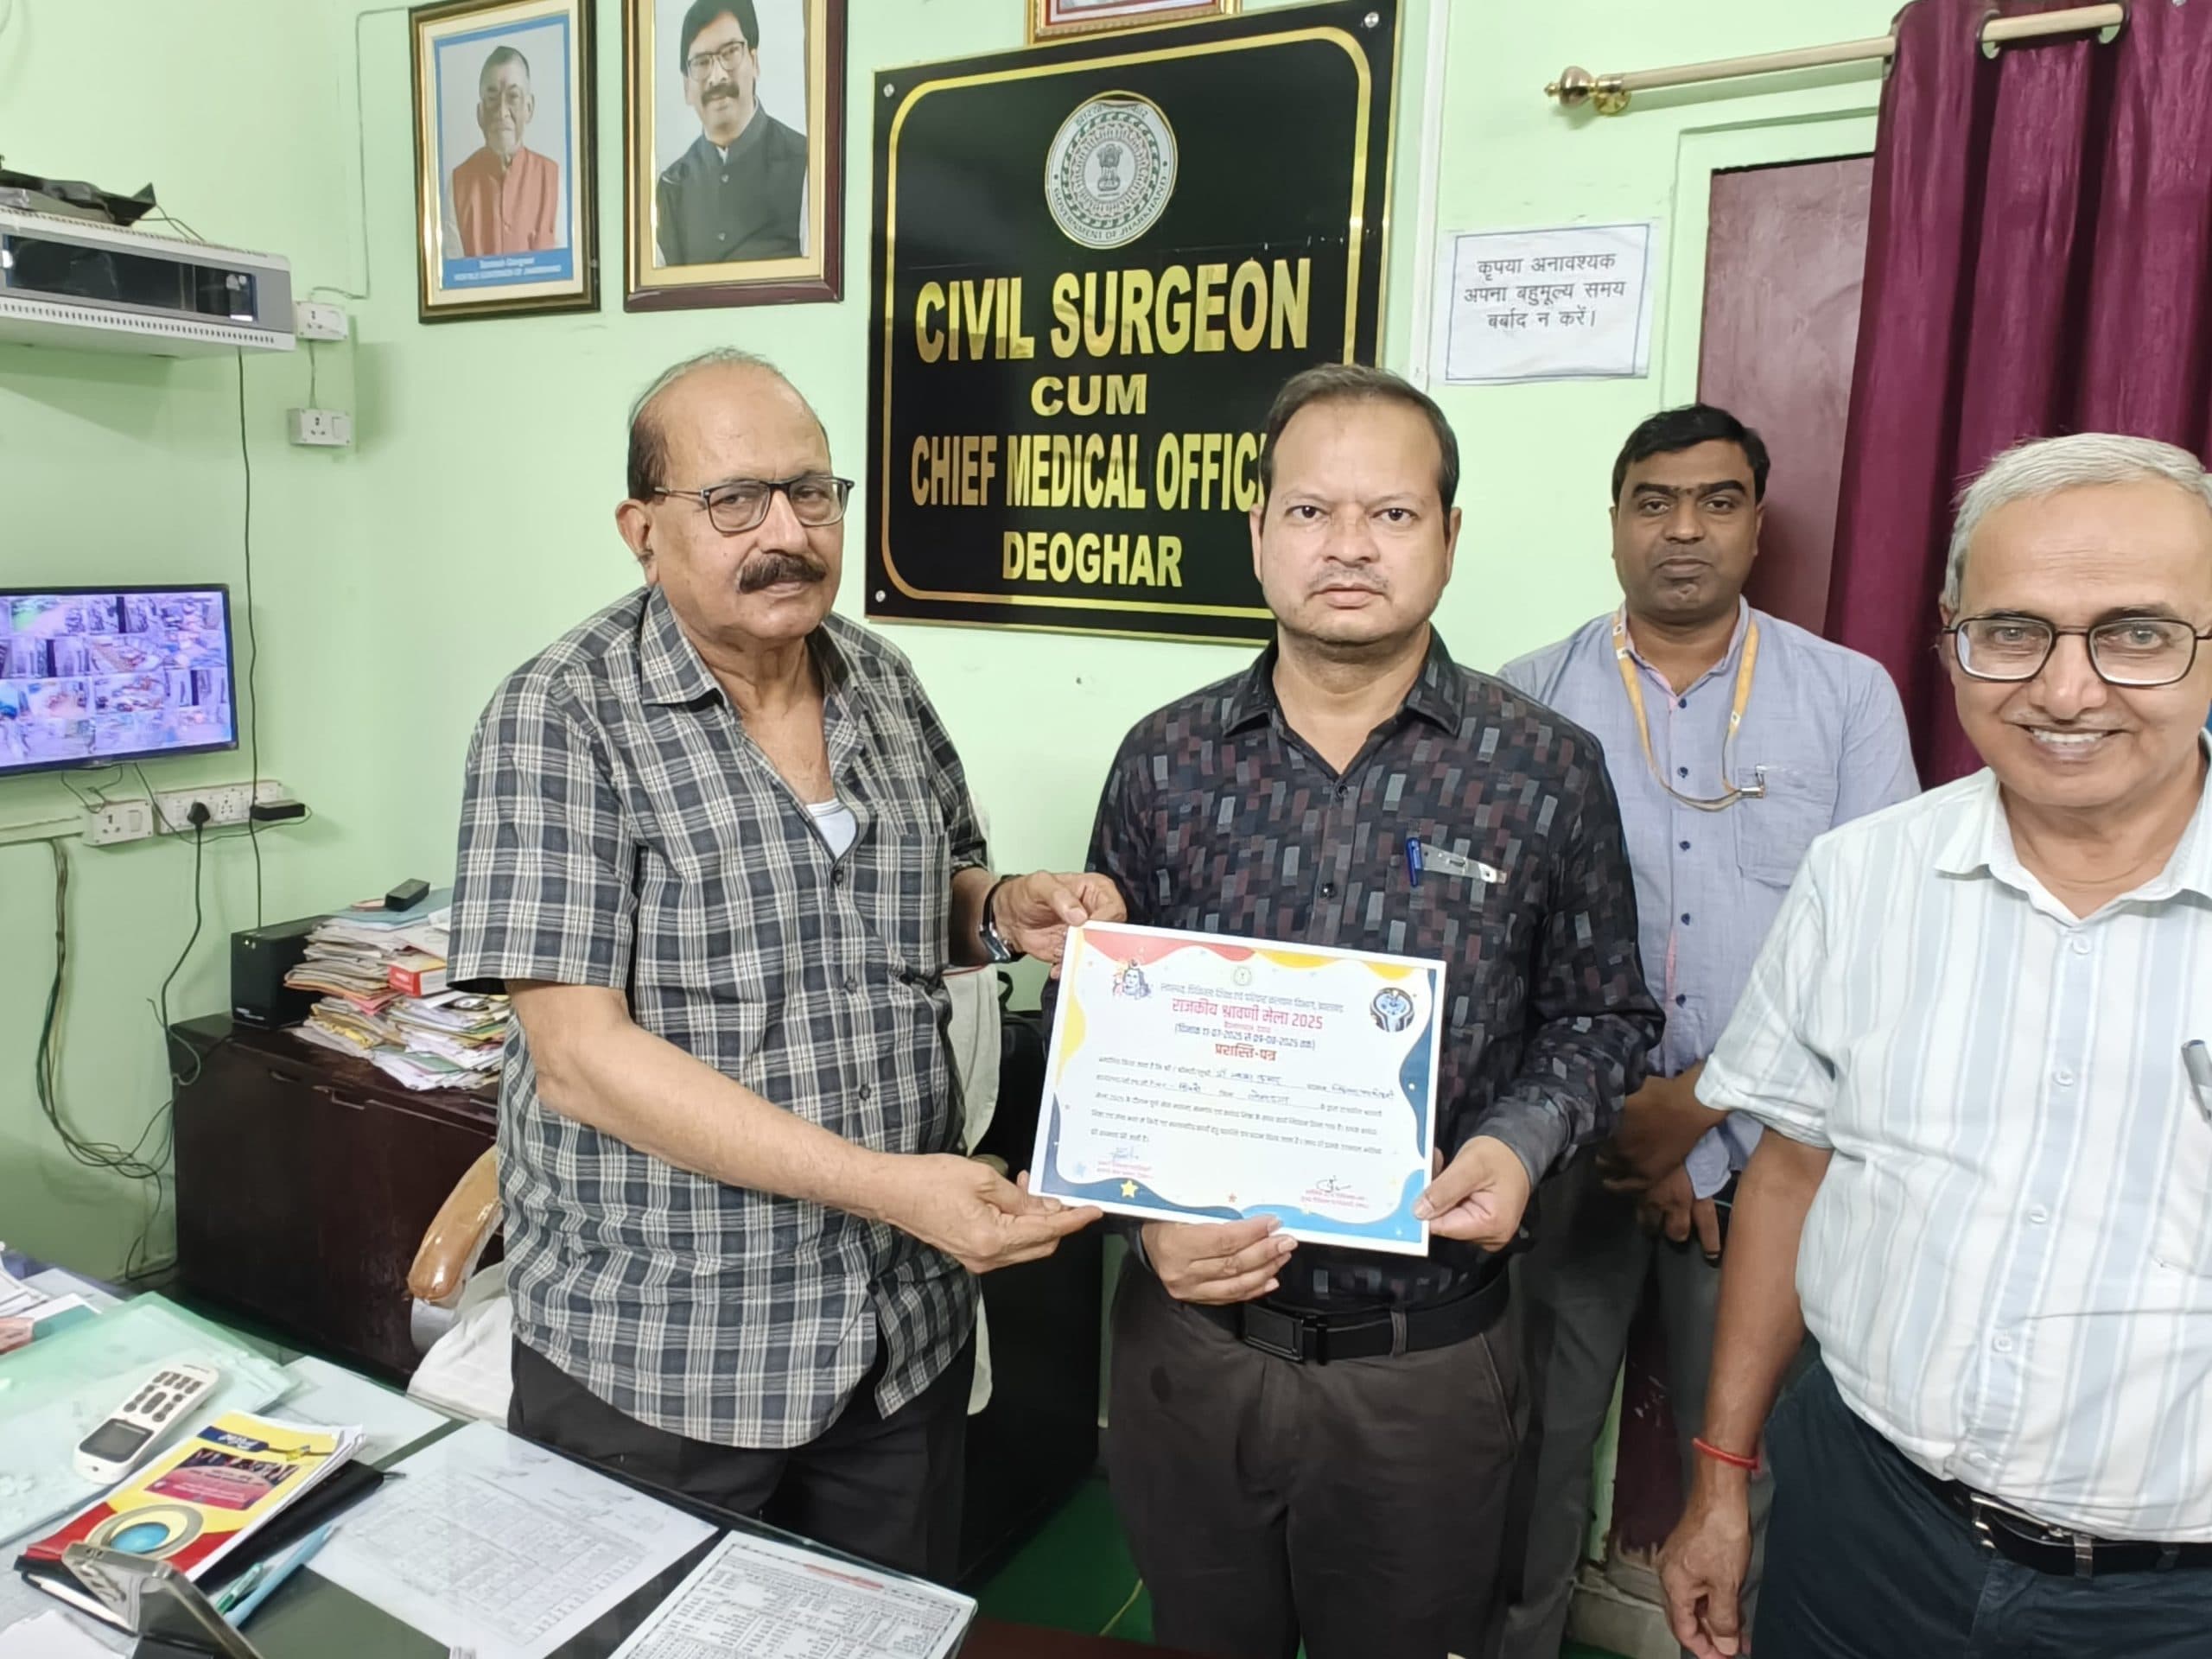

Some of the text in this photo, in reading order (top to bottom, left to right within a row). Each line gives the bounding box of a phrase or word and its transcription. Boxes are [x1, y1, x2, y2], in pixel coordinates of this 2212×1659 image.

[1478, 253, 1618, 281] कृपया अनावश्यक
[915, 257, 1312, 363] CIVIL SURGEON
[1464, 281, 1626, 306] अपना बहुमूल्य समय
[1487, 308, 1529, 329] बर्बाद
[1537, 312, 1551, 327] न
[1031, 373, 1147, 416] CUM
[911, 435, 997, 506] CHIEF
[1006, 434, 1146, 509] MEDICAL
[1002, 531, 1183, 588] DEOGHAR
[1173, 998, 1217, 1016] राजकीय
[1222, 1003, 1259, 1021] श्रावणी
[1262, 1007, 1290, 1026] मेला
[1292, 1013, 1324, 1029] 2025
